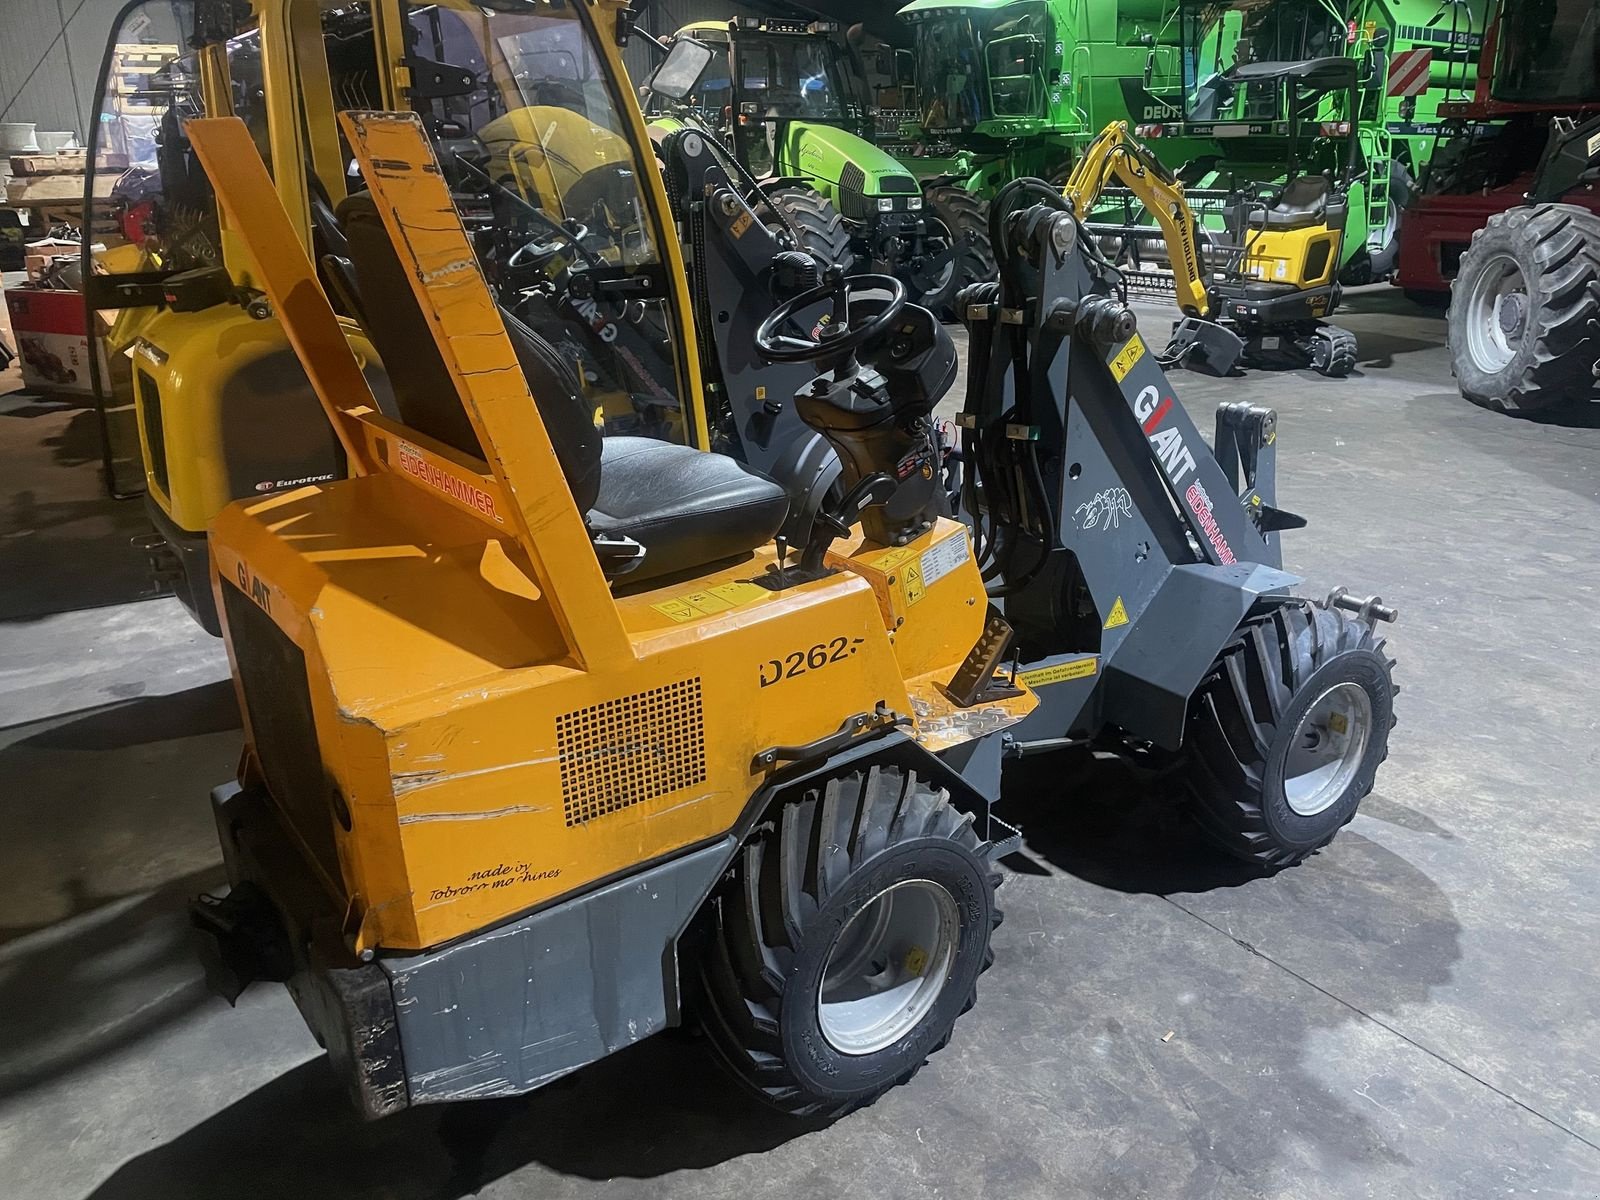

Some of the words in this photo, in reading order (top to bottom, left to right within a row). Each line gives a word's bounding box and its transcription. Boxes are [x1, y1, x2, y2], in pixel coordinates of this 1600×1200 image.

[1143, 105, 1182, 119] DEUT
[1183, 238, 1196, 283] HOLLAND
[1134, 385, 1197, 485] GIANT
[276, 474, 334, 488] Eurotrac
[399, 451, 497, 519] EIDENHAMMER
[1185, 484, 1237, 566] EIDENHAMM
[236, 560, 272, 615] GIANT
[467, 864, 513, 881] made
